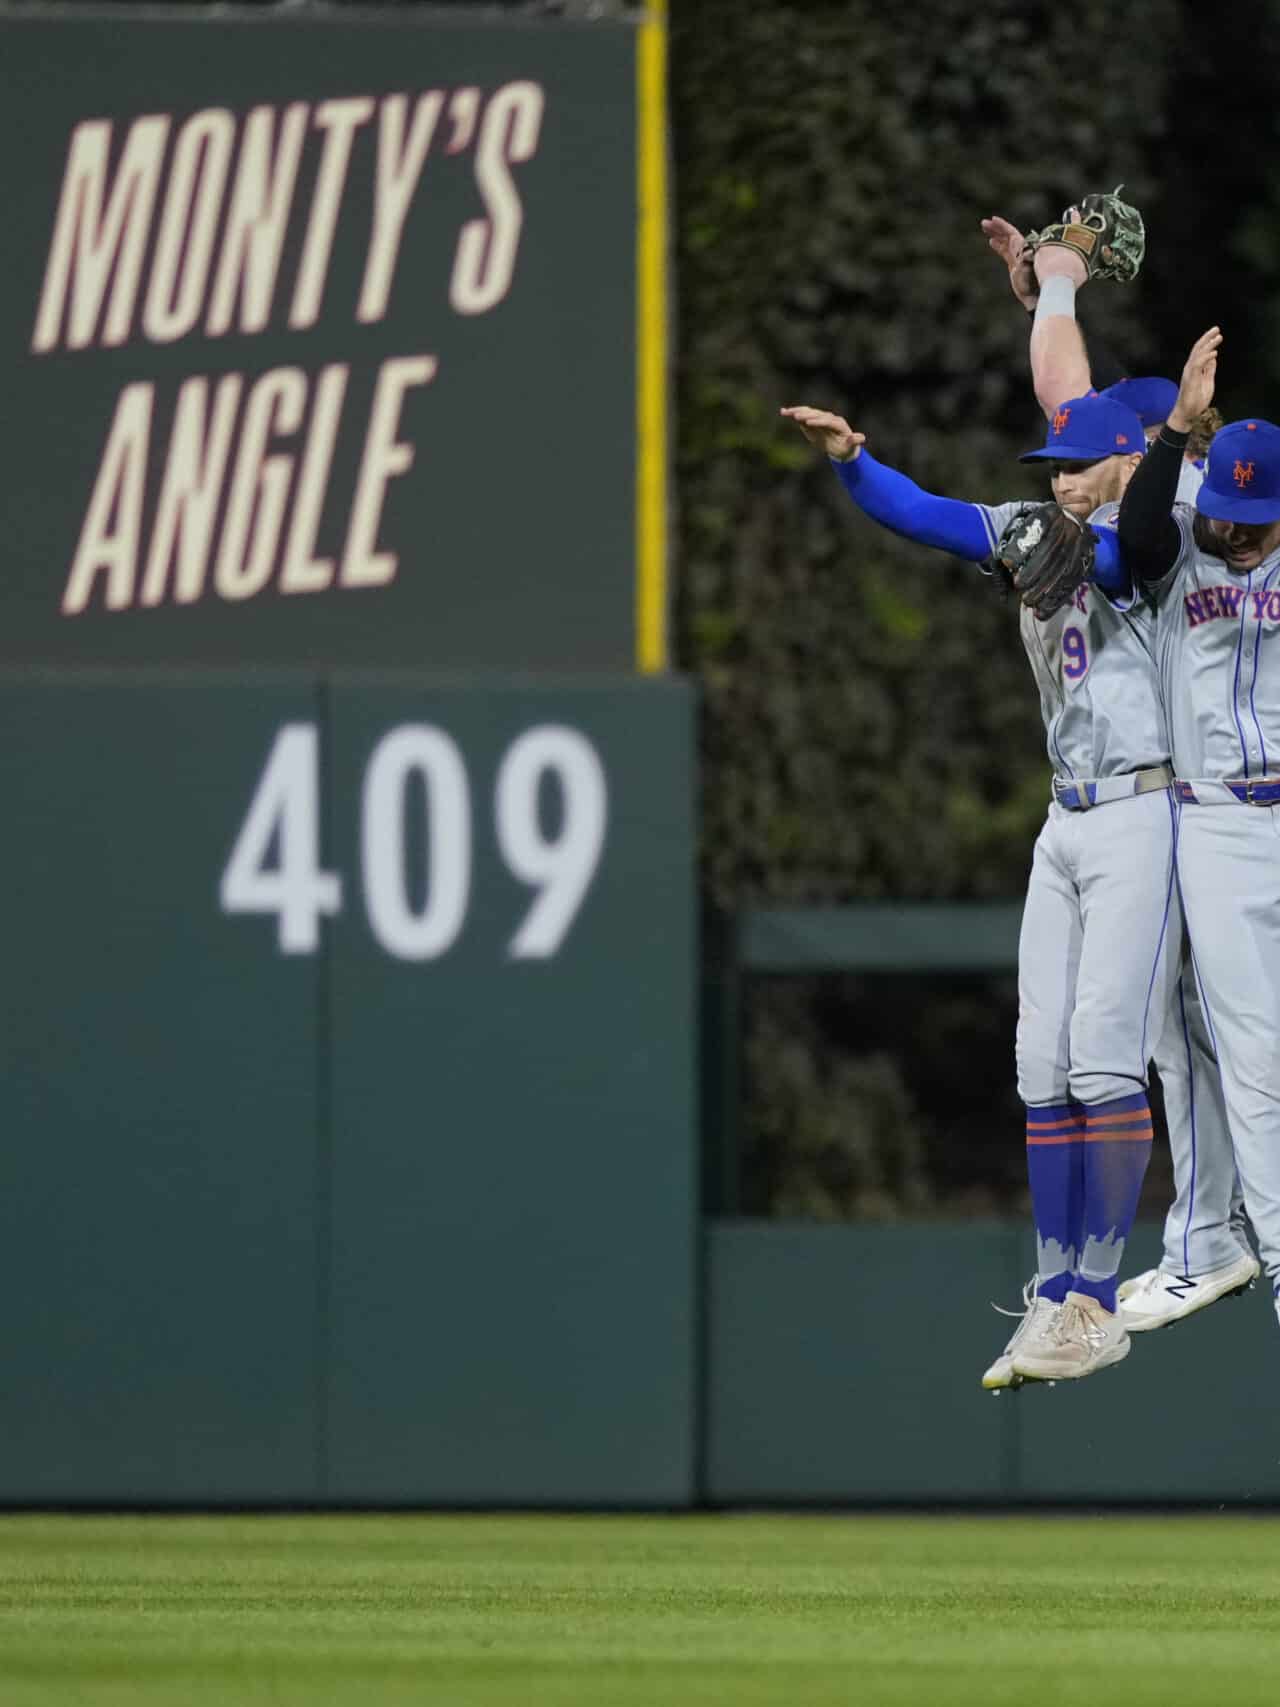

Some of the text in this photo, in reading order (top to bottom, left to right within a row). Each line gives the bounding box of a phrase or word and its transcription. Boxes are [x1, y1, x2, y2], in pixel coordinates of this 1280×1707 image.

[31, 80, 545, 354] MONTY'S
[61, 354, 438, 616] ANGLE
[1062, 626, 1089, 679] 9
[1184, 586, 1246, 628] NEW
[220, 721, 608, 960] 409
